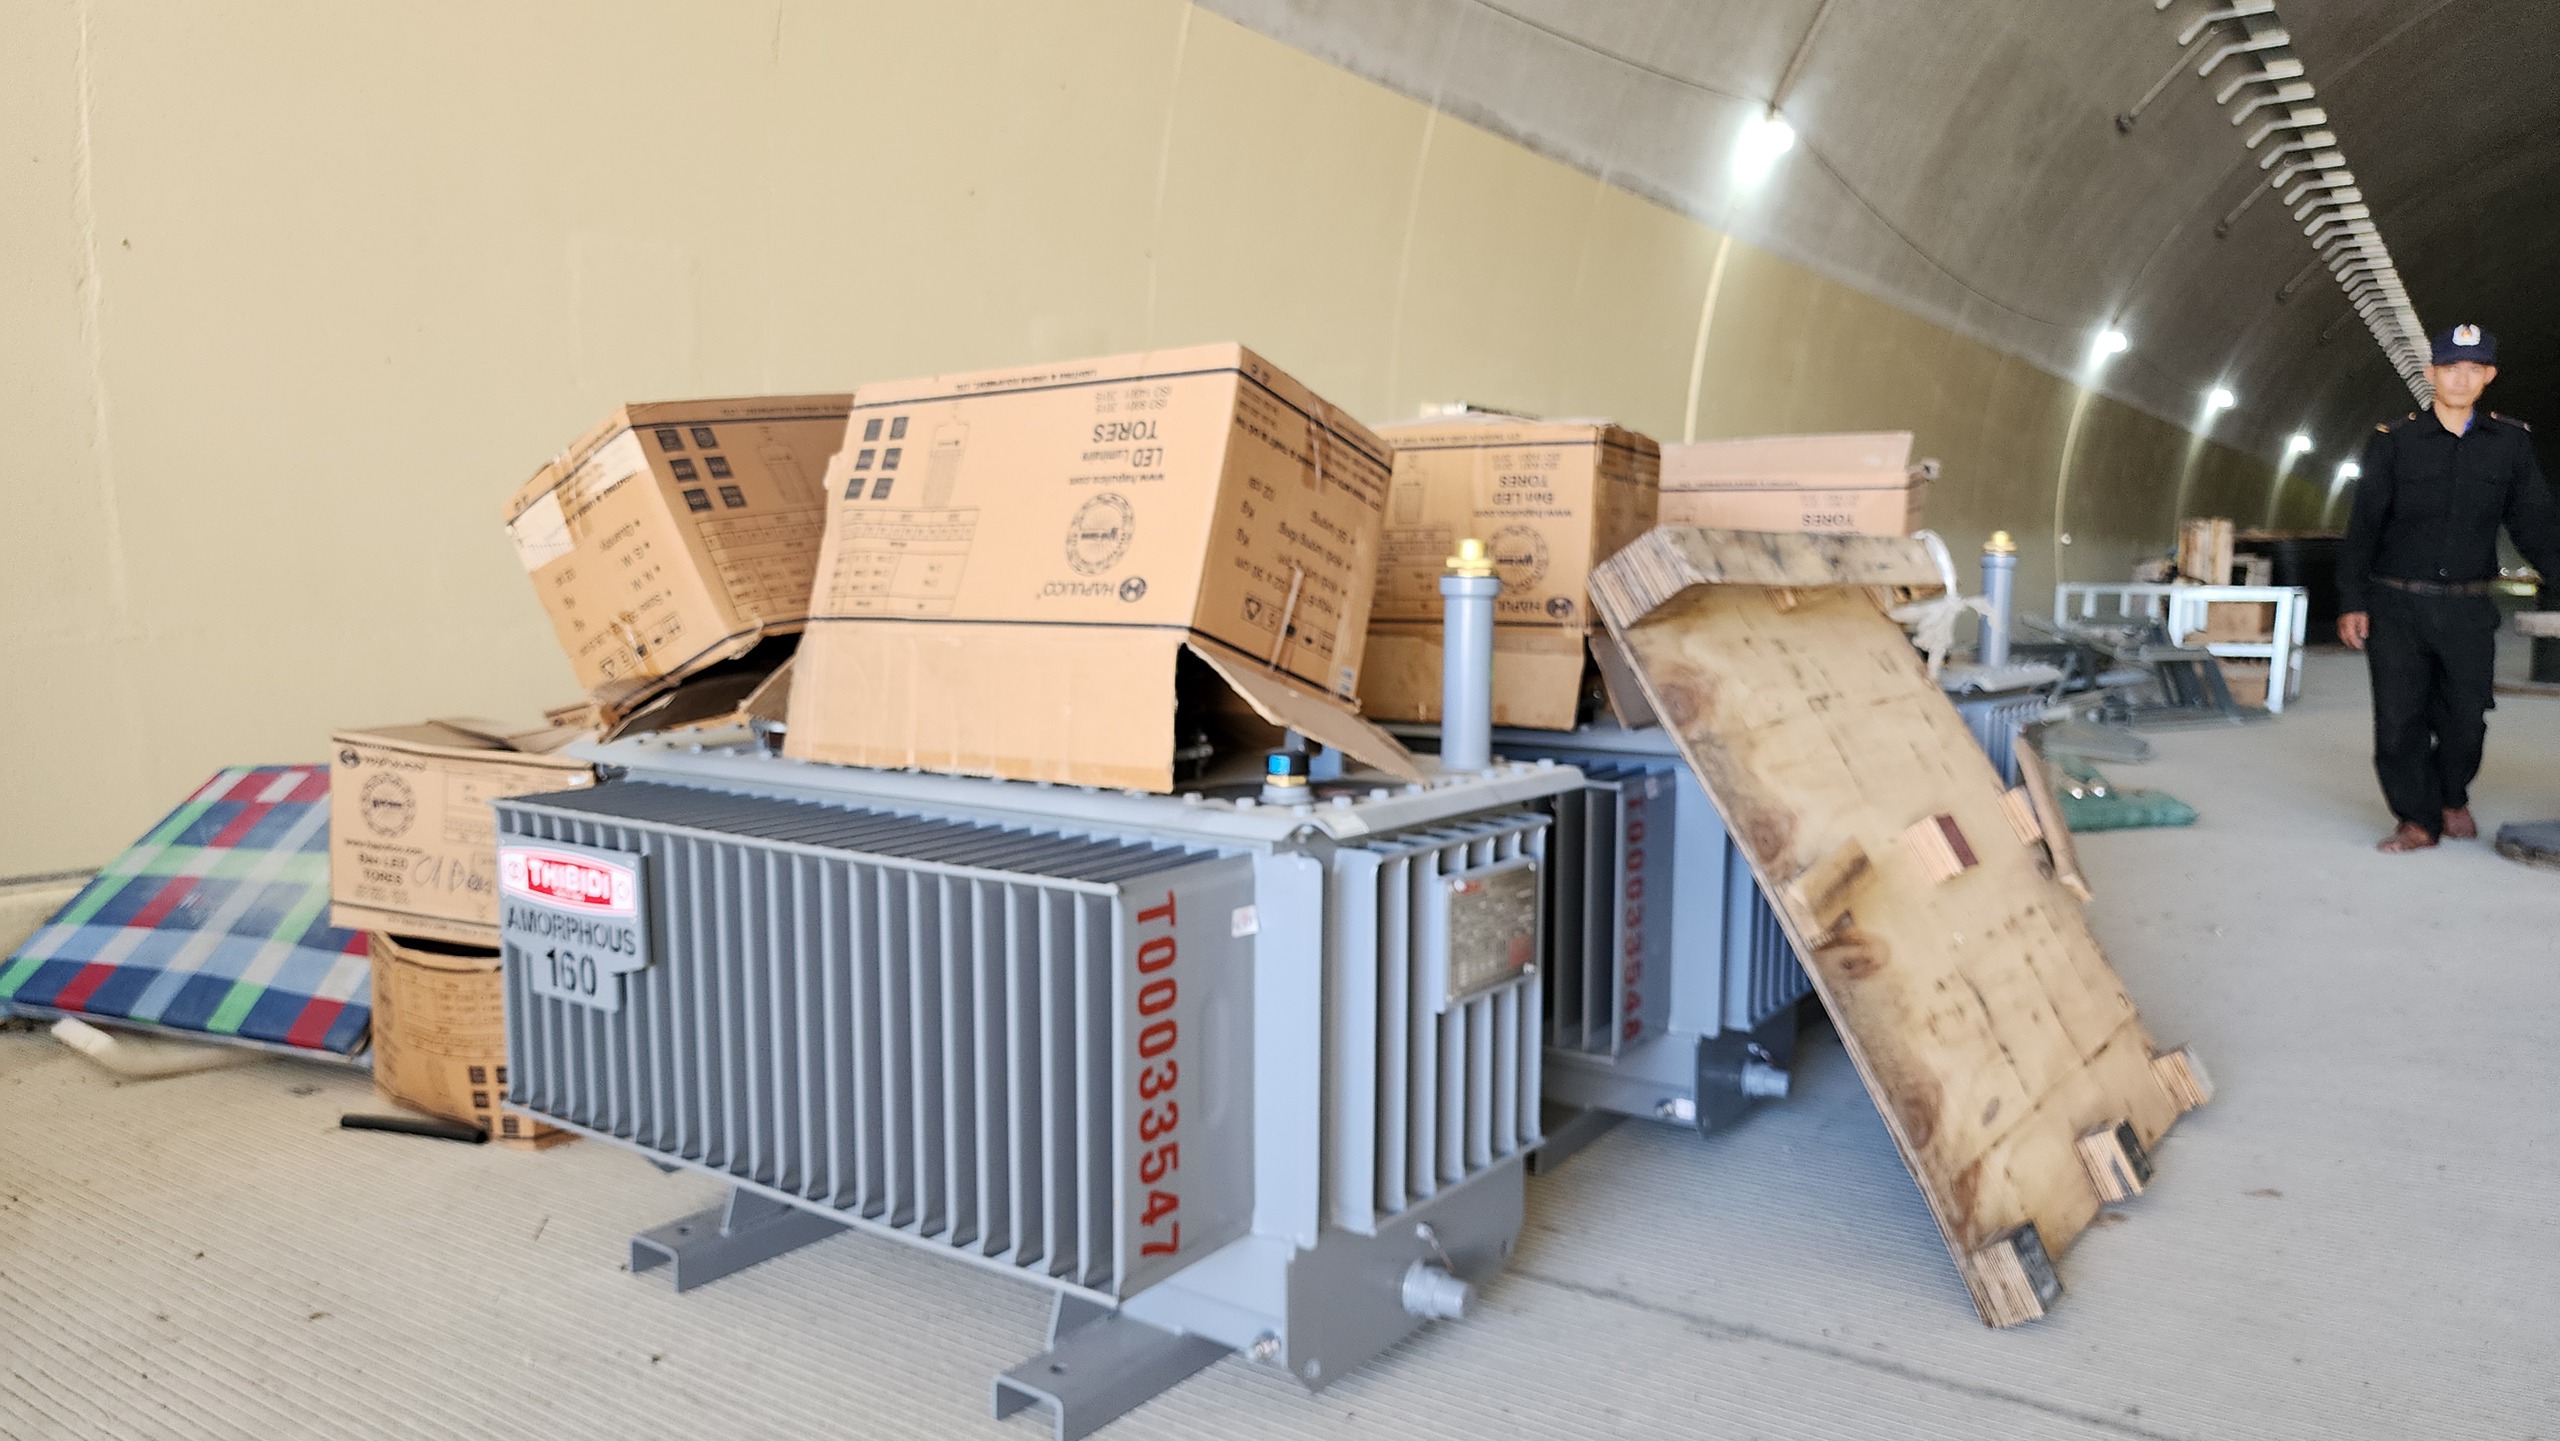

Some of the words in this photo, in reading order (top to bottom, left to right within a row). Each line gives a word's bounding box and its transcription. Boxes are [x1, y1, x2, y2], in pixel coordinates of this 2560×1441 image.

[1092, 419, 1158, 443] TORES
[1132, 447, 1163, 468] LED
[1499, 474, 1549, 488] TORES
[1492, 492, 1520, 505] LED
[527, 857, 612, 901] THIBIDI
[506, 906, 636, 955] AMORPHOUS
[546, 948, 597, 997] 160
[1136, 889, 1181, 1258] T00033547
